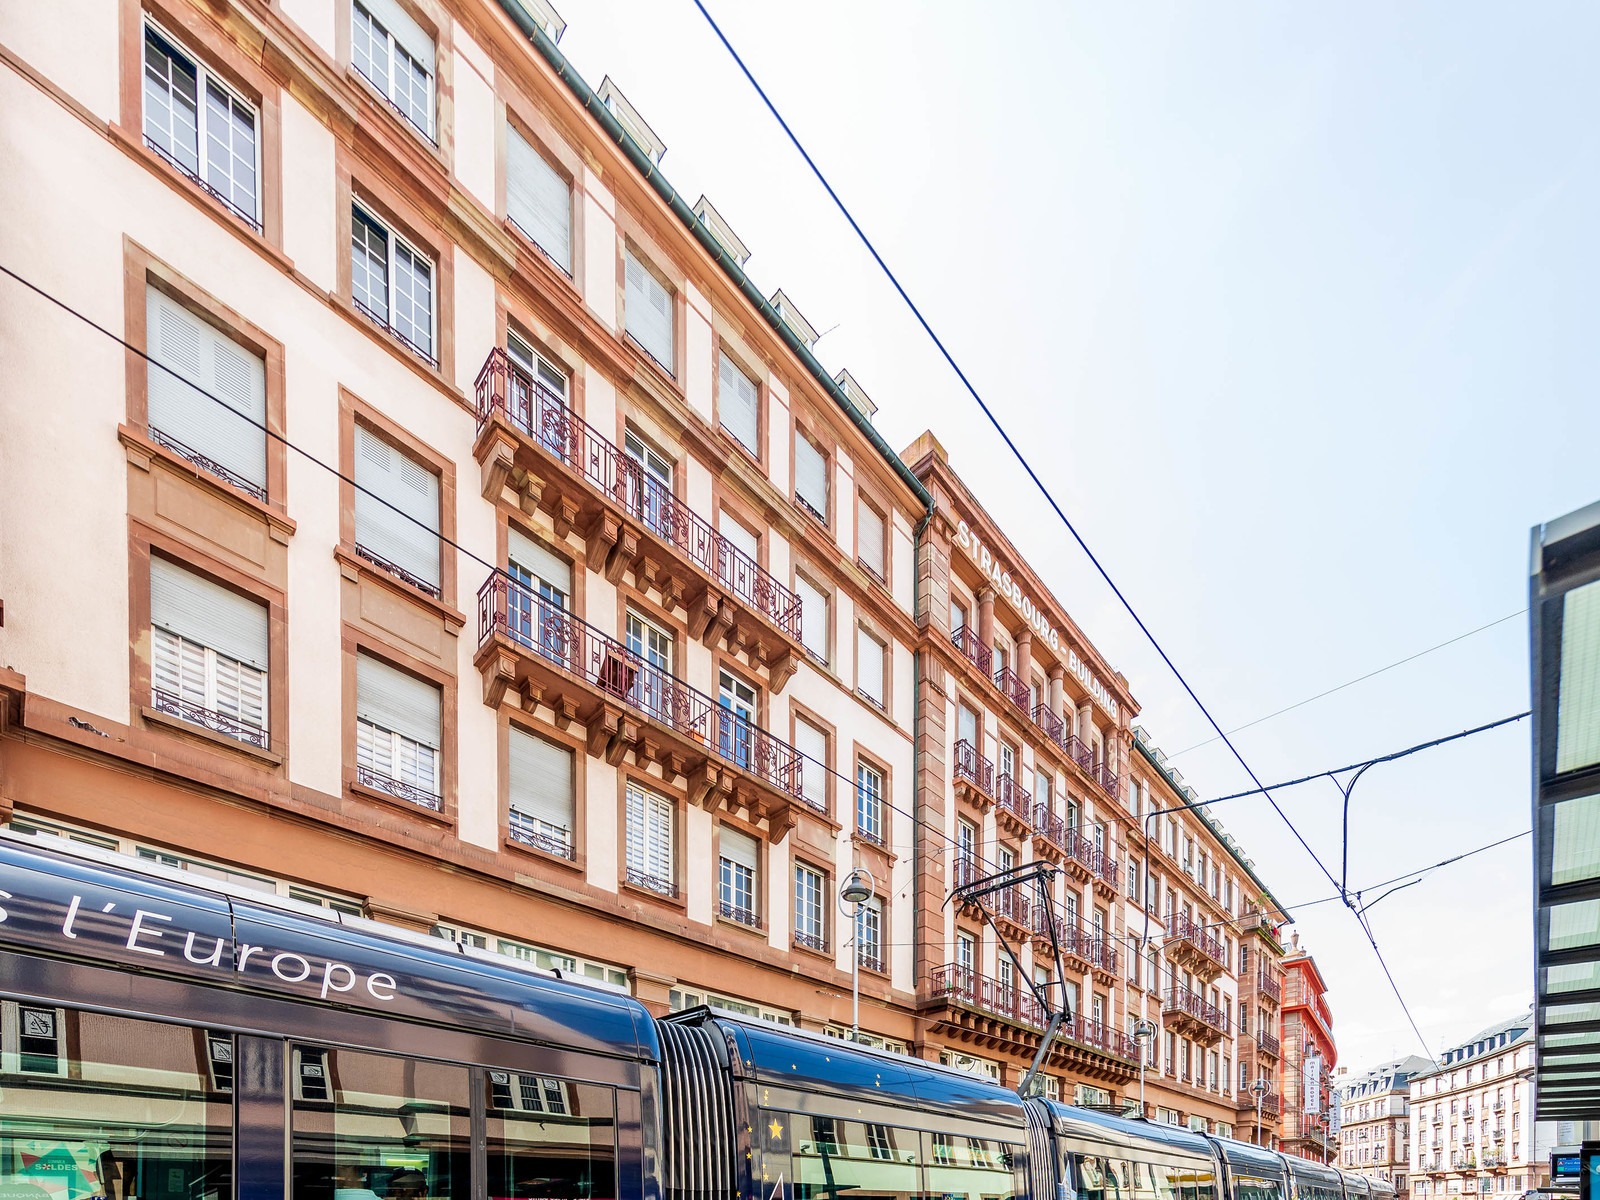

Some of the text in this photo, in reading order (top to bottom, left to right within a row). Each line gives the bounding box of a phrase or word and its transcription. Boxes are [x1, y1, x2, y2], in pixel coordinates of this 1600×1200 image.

[956, 520, 1060, 652] STRASBOURG
[1067, 650, 1118, 720] BUILDING
[61, 895, 398, 1001] l'Europe
